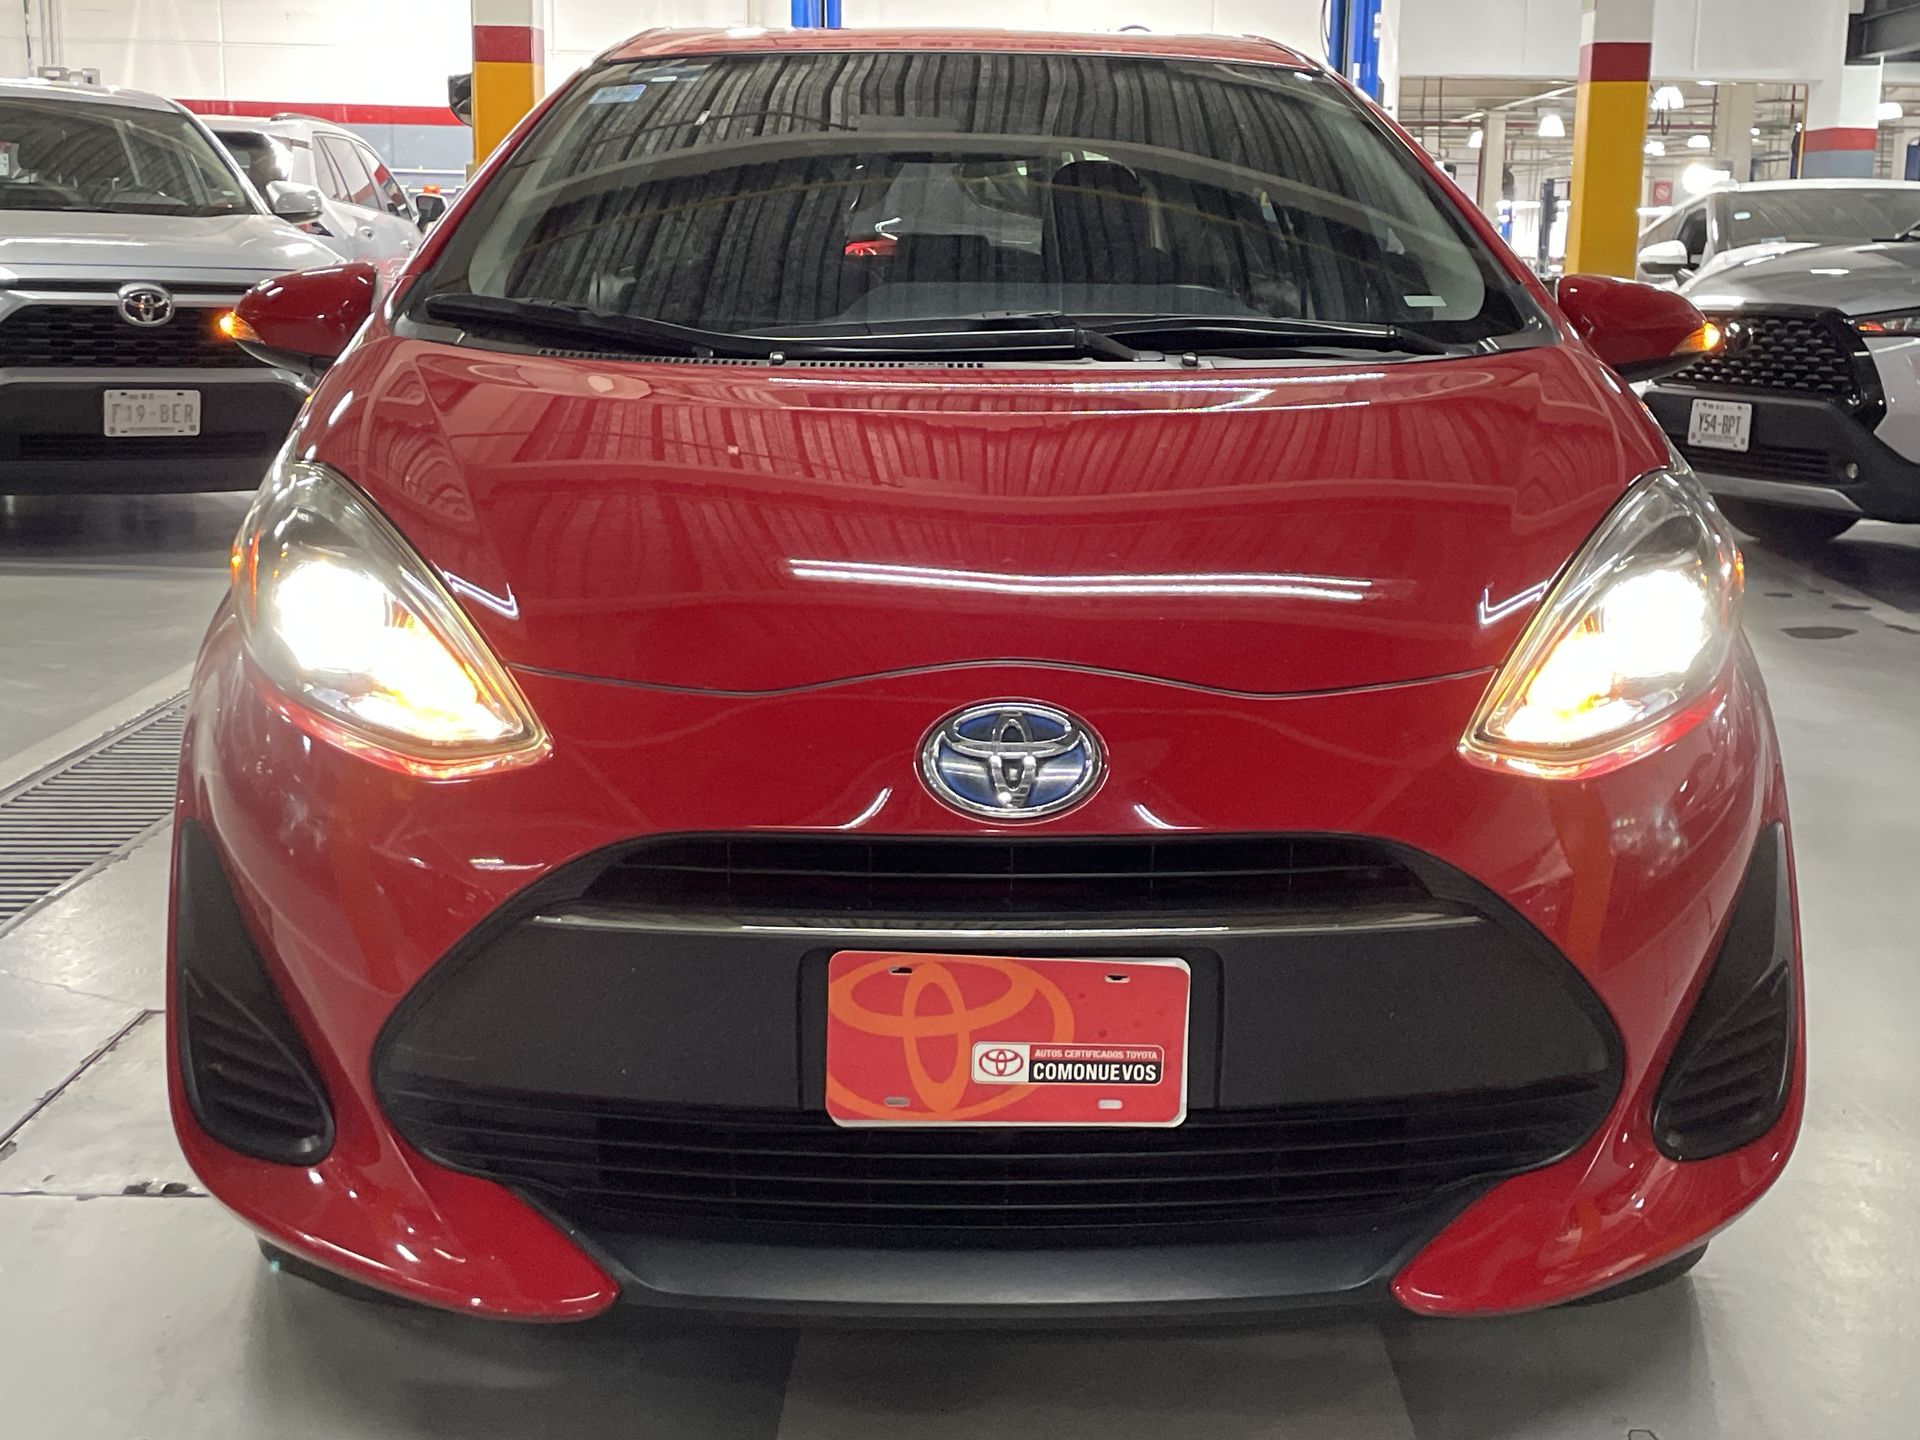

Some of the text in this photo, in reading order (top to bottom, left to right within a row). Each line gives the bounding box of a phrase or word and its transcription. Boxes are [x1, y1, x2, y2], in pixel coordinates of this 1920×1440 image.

[1034, 1049, 1158, 1060] AUTOS CERTIFICADOS TOYOTA
[1033, 1062, 1157, 1081] COMONUEVOS
